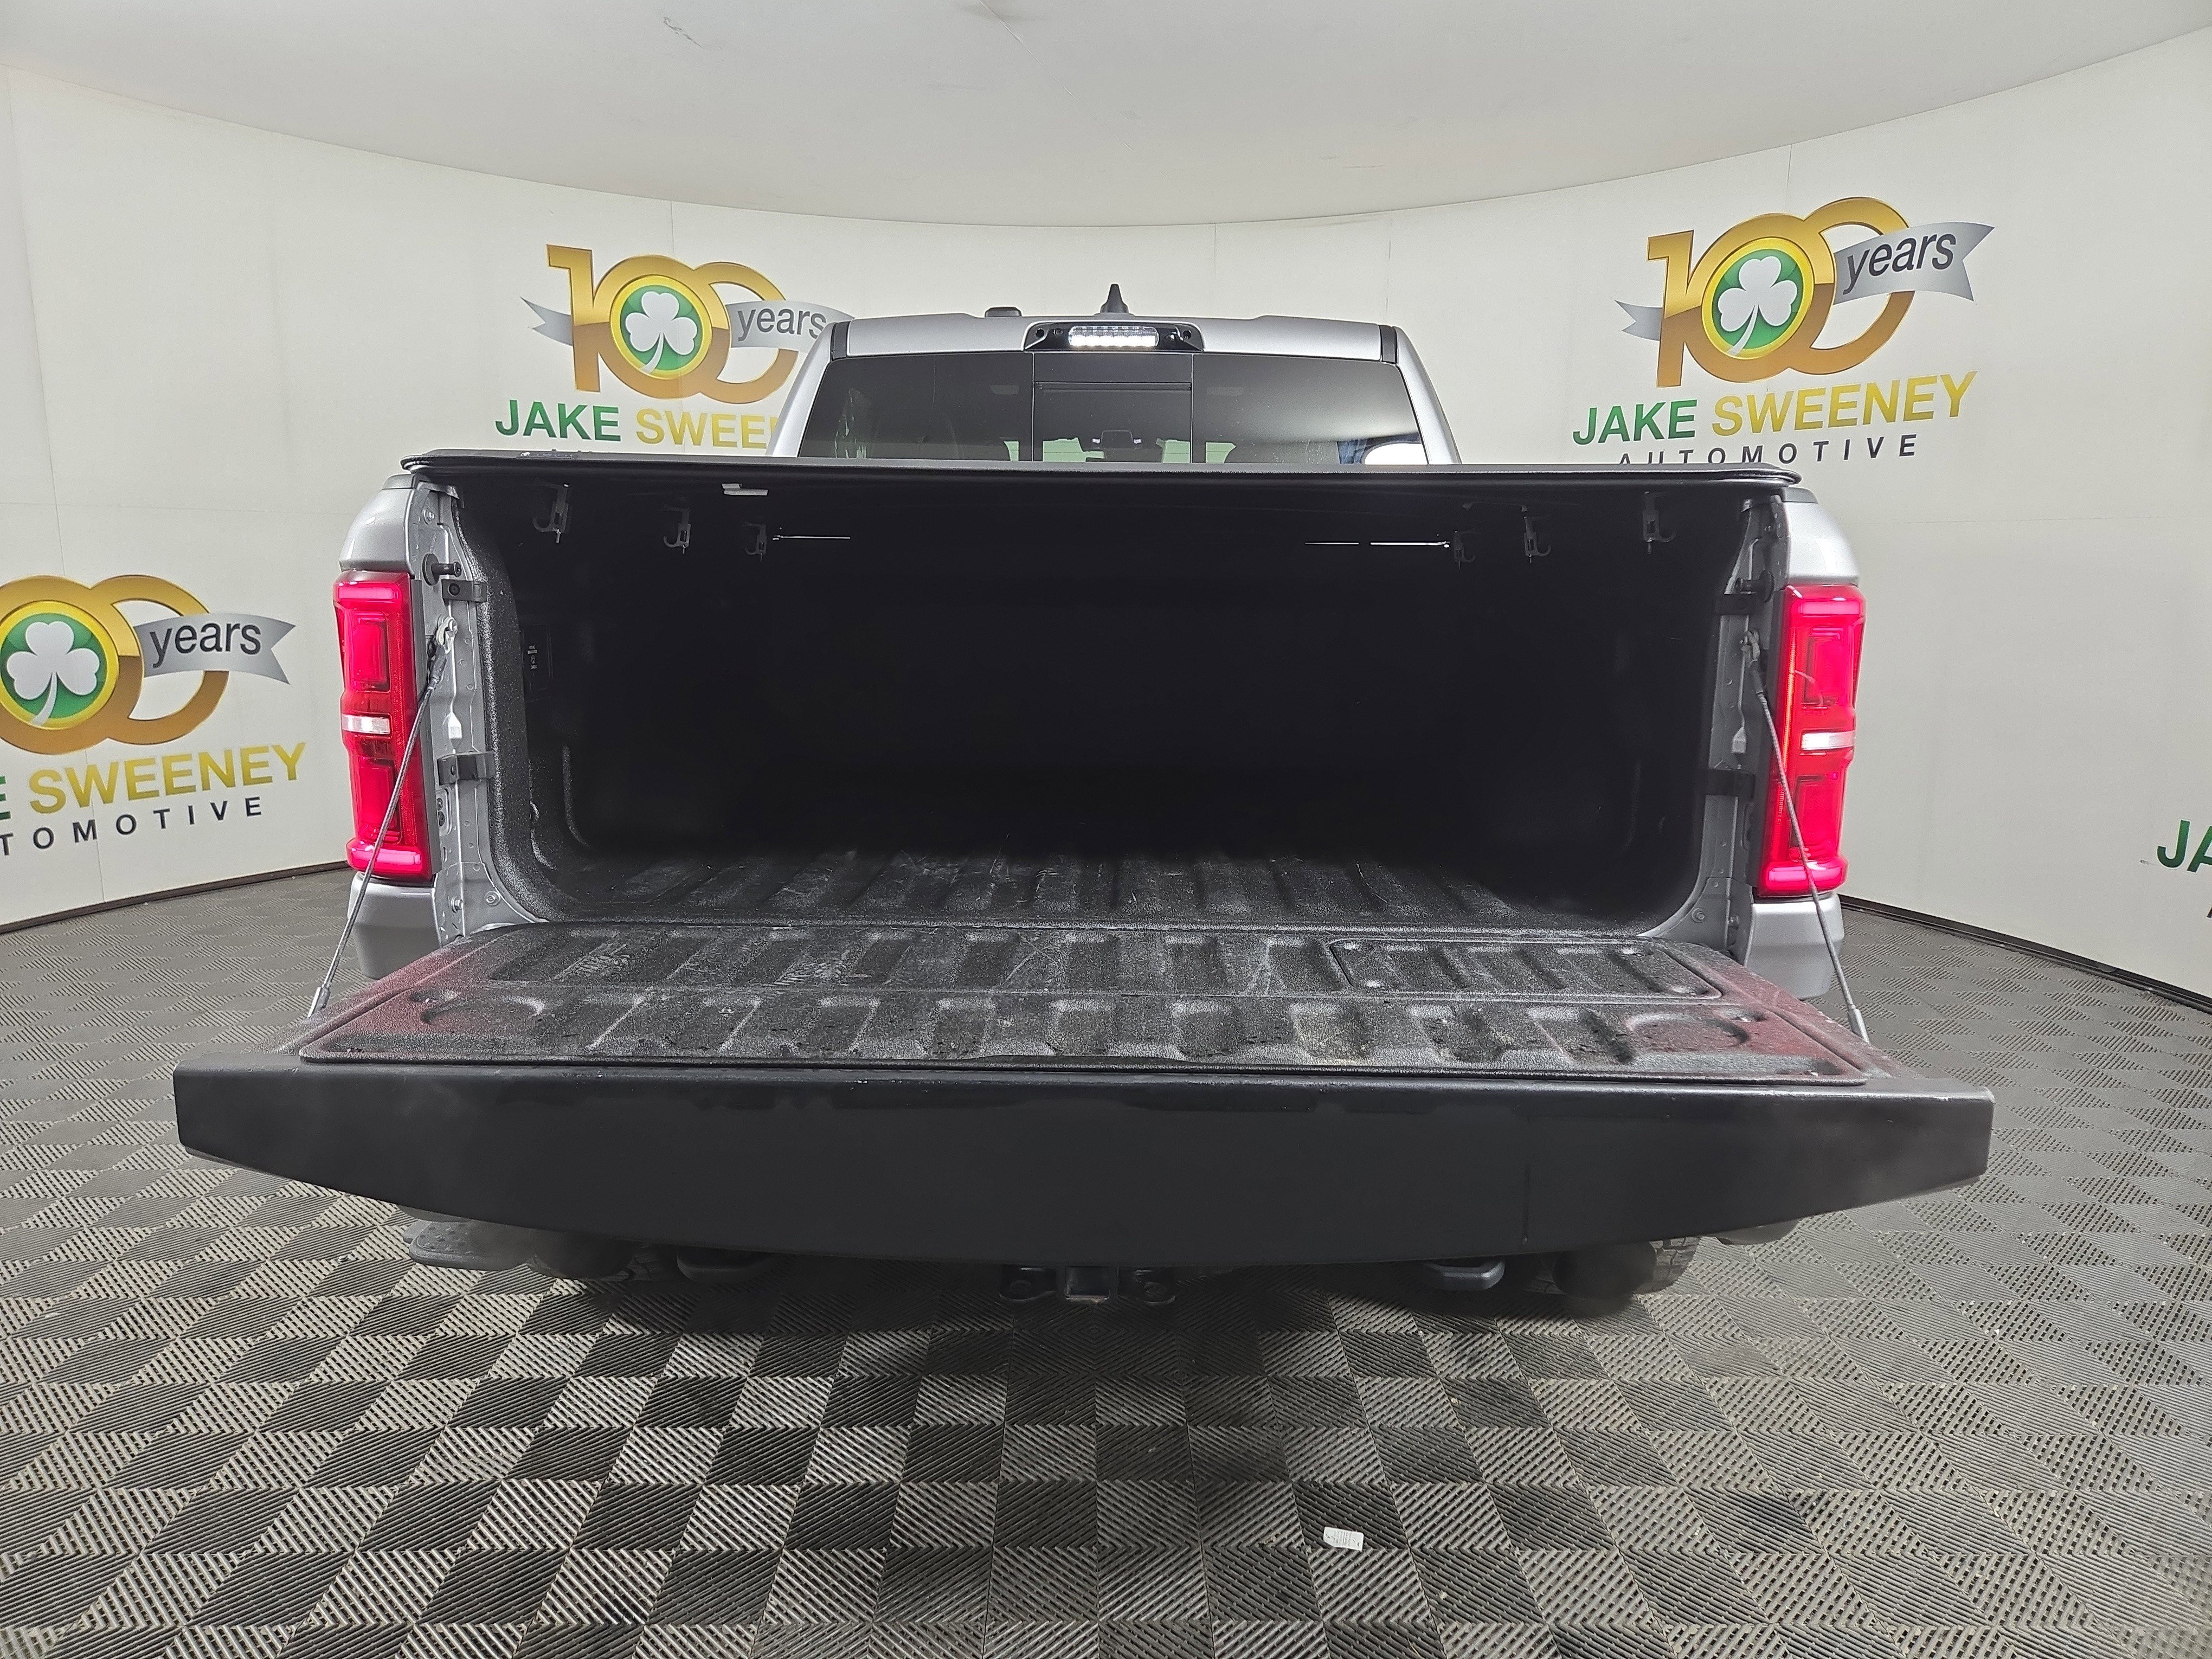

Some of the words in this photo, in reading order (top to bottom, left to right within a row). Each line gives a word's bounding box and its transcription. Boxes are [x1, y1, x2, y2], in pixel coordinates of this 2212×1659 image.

[1647, 196, 1915, 388] 100
[1843, 233, 1956, 295] years
[738, 308, 827, 342] years
[495, 400, 622, 442] JAKE
[1572, 399, 1698, 445] JAKE
[1712, 371, 1978, 436] SWEENEY
[150, 622, 261, 668] years
[29, 742, 306, 814] SWEENEY
[0, 796, 262, 856] TOMOTIVE
